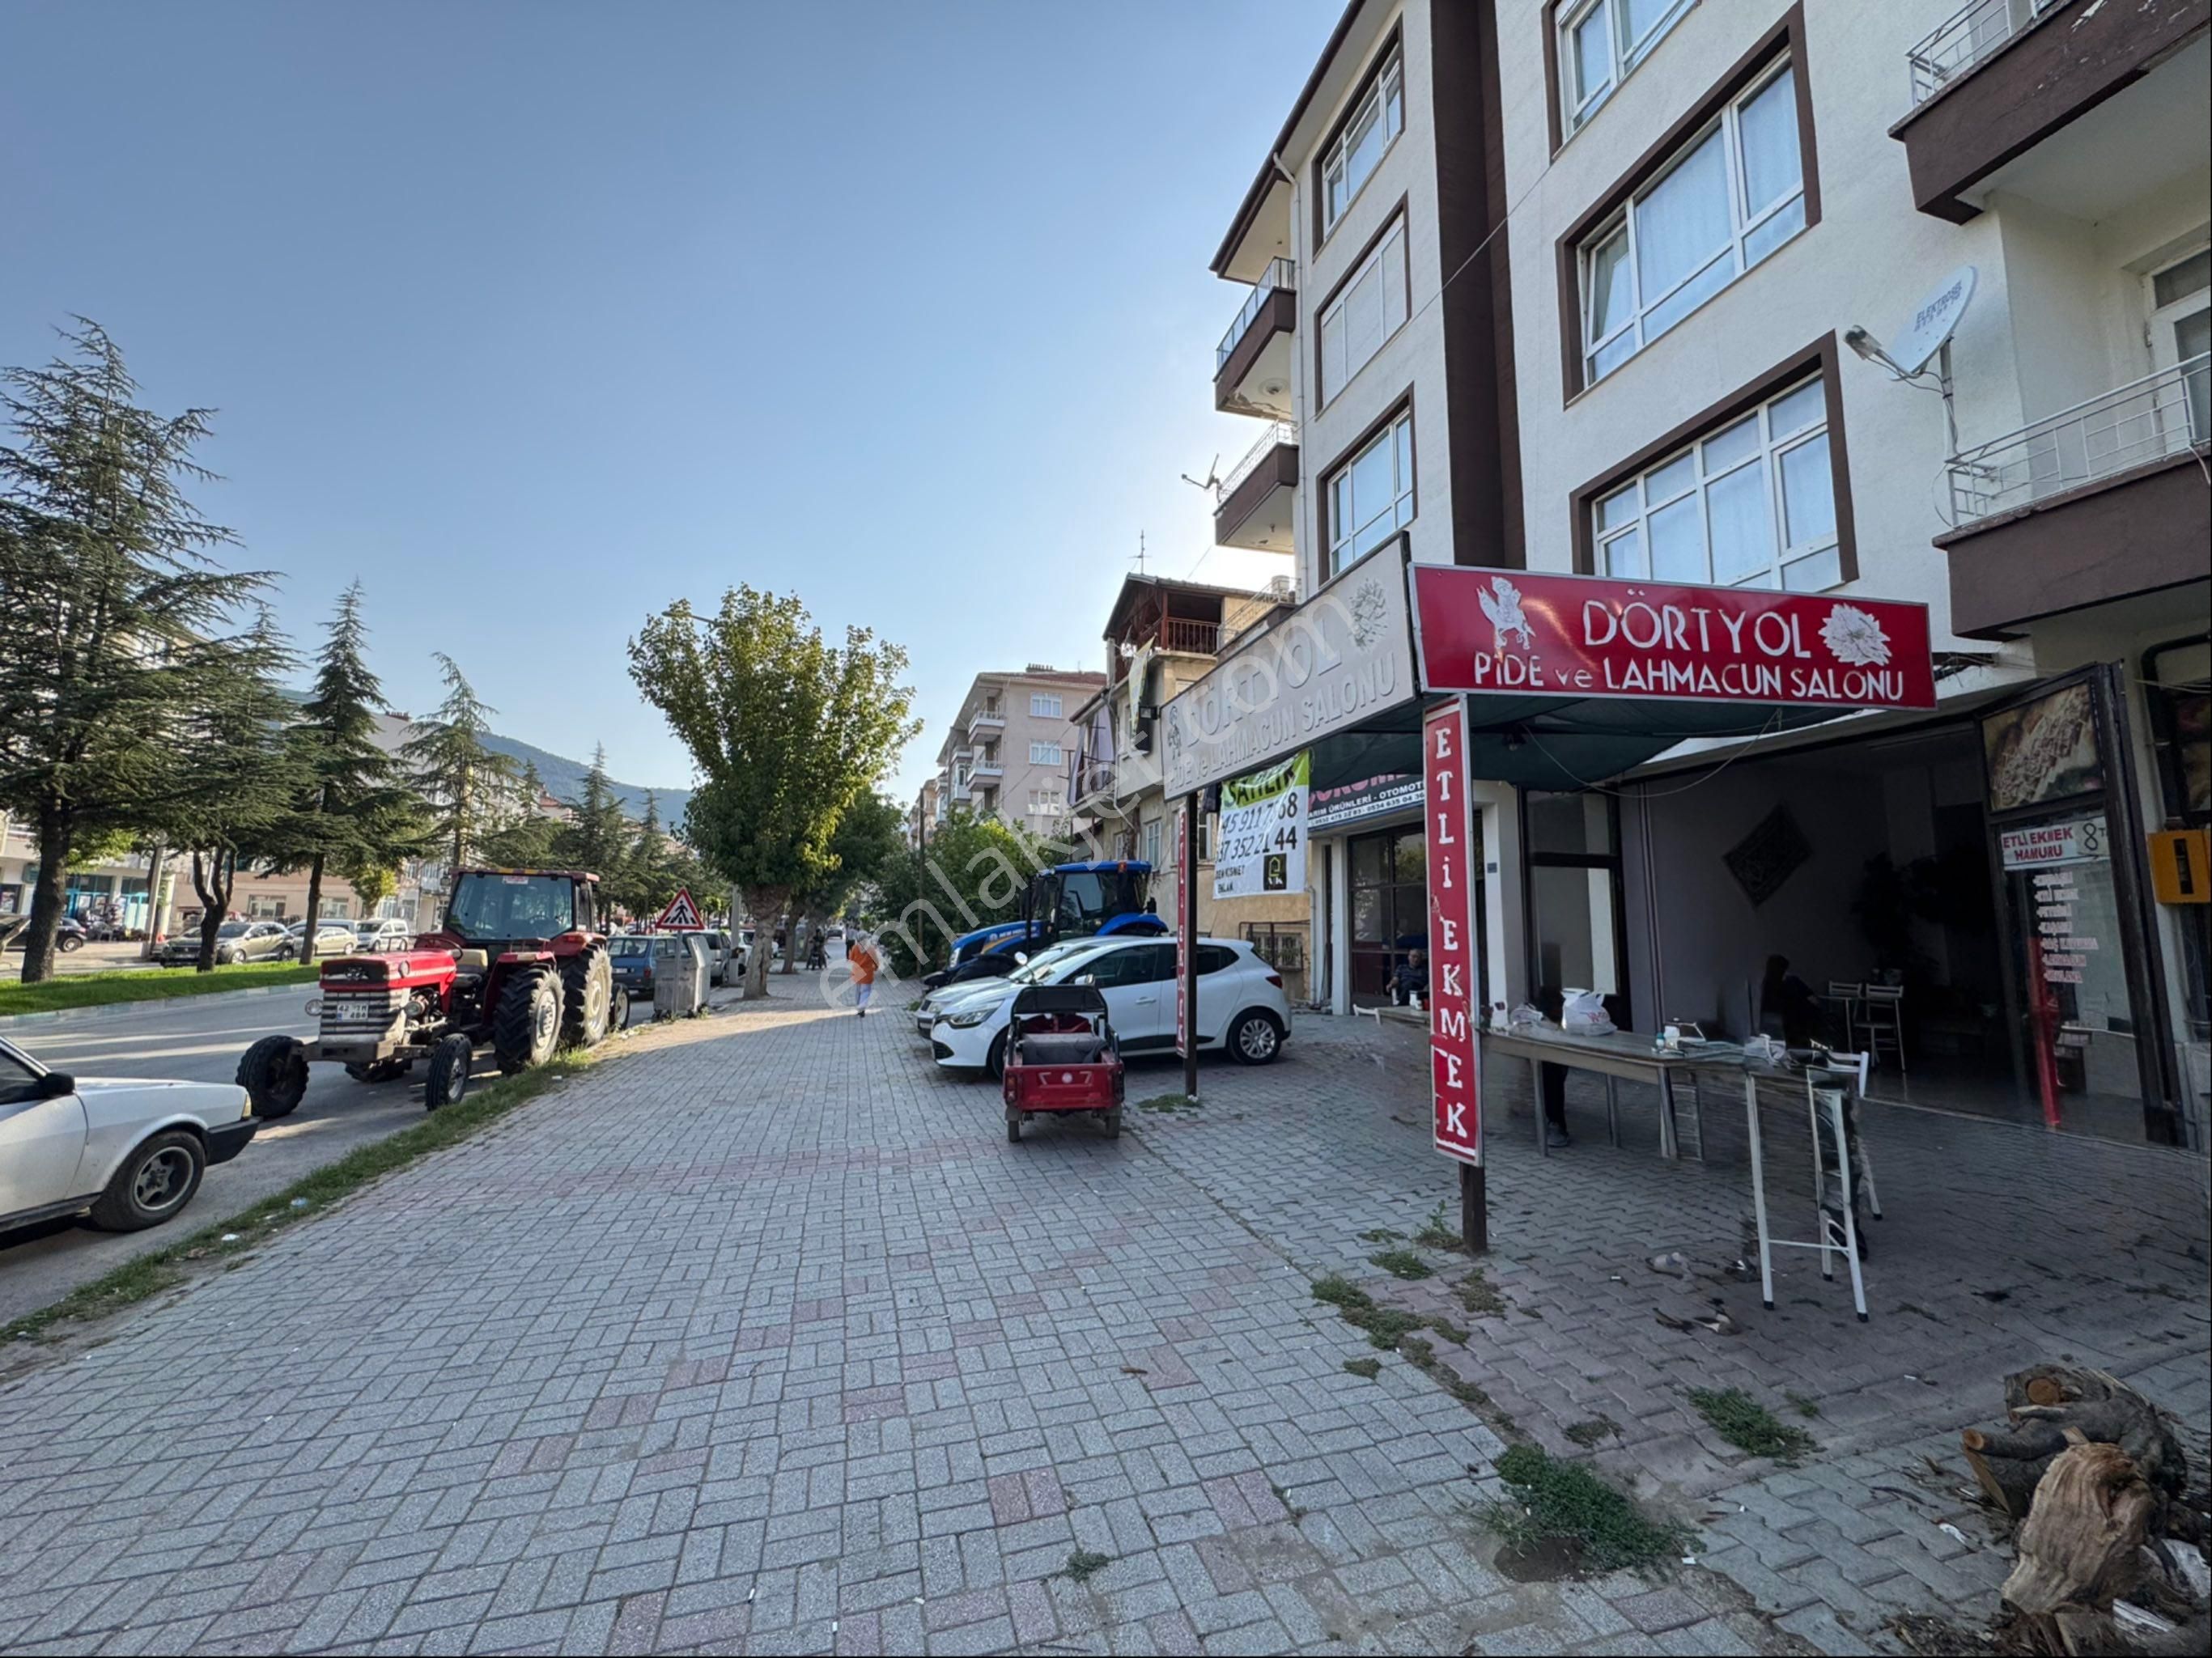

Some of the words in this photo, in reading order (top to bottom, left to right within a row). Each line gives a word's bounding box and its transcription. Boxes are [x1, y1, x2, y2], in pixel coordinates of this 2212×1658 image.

[1582, 588, 1811, 659] DÖRTYOL
[1302, 651, 1396, 732] SALONU
[1555, 669, 1593, 687] ve
[1603, 657, 1782, 696] LAHMACUN
[1790, 668, 1903, 701] SALONU
[1328, 793, 1372, 813] ÜRÜNLERİ
[1221, 812, 1240, 835] 45
[2083, 822, 2099, 851] 8
[1274, 826, 1297, 851] 44
[2015, 844, 2063, 861] HAMURU
[1440, 919, 1468, 1138] EKMEK
